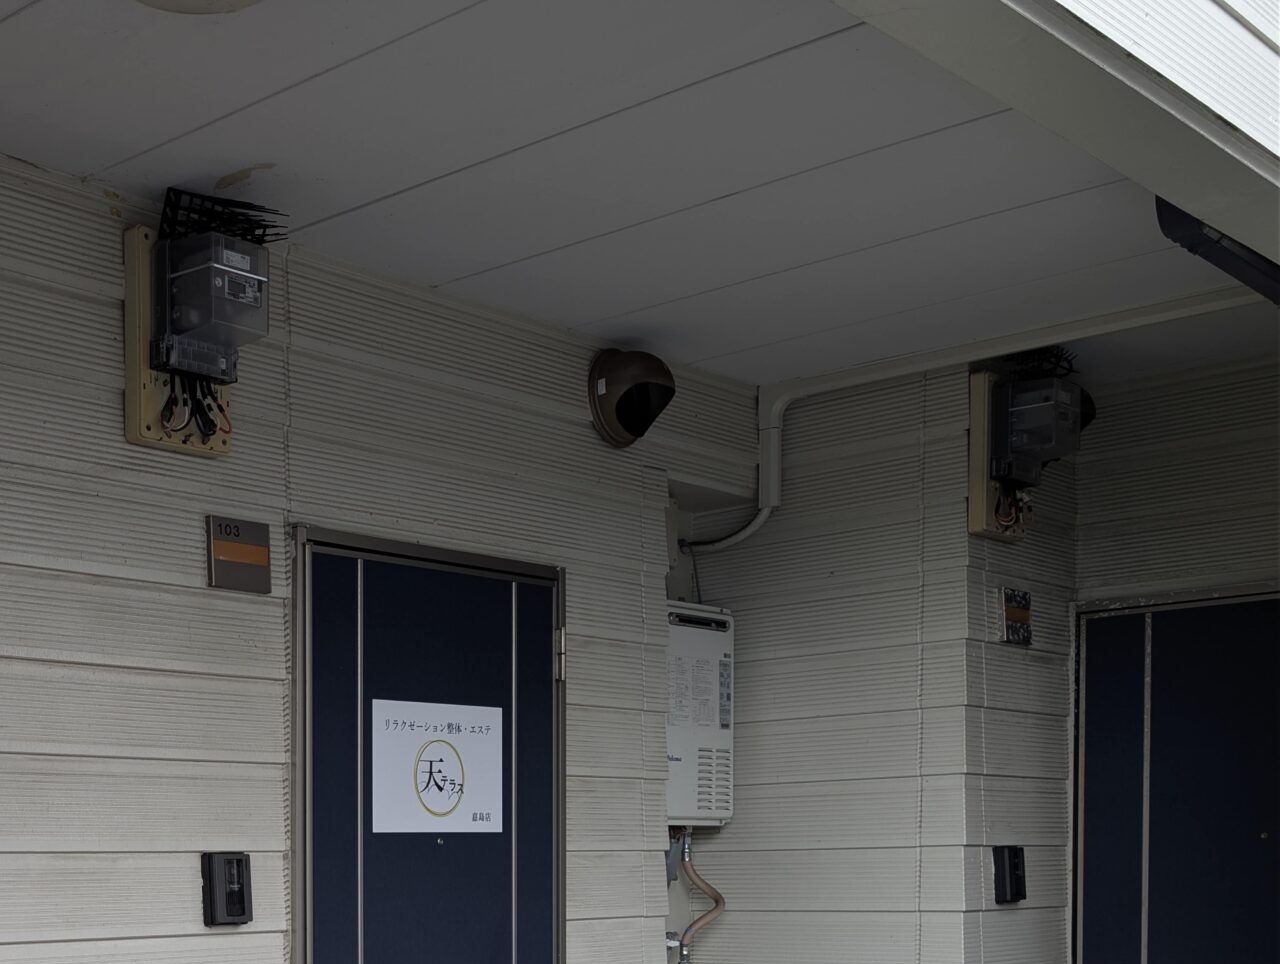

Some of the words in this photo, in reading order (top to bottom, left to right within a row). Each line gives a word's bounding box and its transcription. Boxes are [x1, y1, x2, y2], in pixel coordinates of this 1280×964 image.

[217, 523, 241, 538] 103
[384, 719, 492, 736] リラクゼーション整体・エステ
